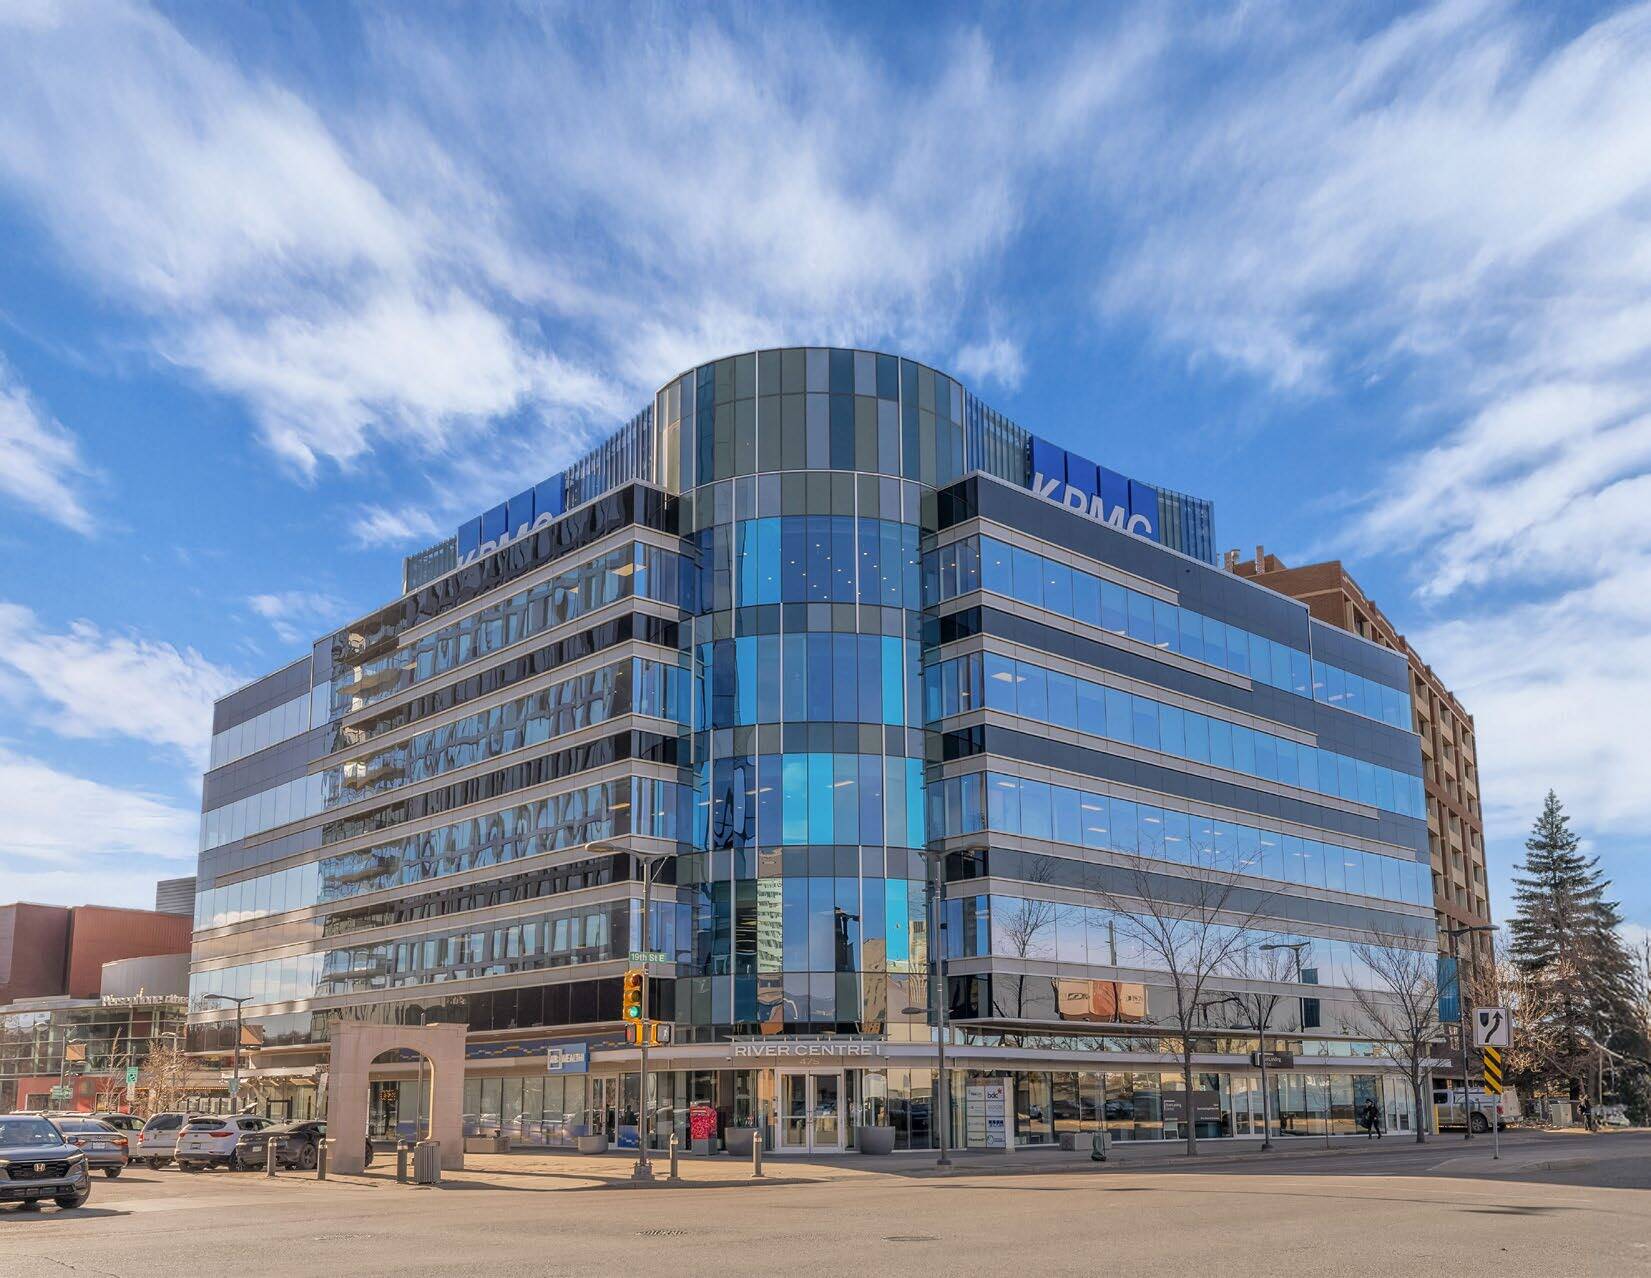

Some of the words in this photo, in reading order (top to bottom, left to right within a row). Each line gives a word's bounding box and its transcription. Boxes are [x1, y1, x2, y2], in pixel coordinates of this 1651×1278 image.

[631, 953, 647, 961] 19th
[649, 953, 658, 962] St
[659, 954, 665, 962] E
[735, 1046, 789, 1056] RIVER
[794, 1045, 872, 1056] CENTRE
